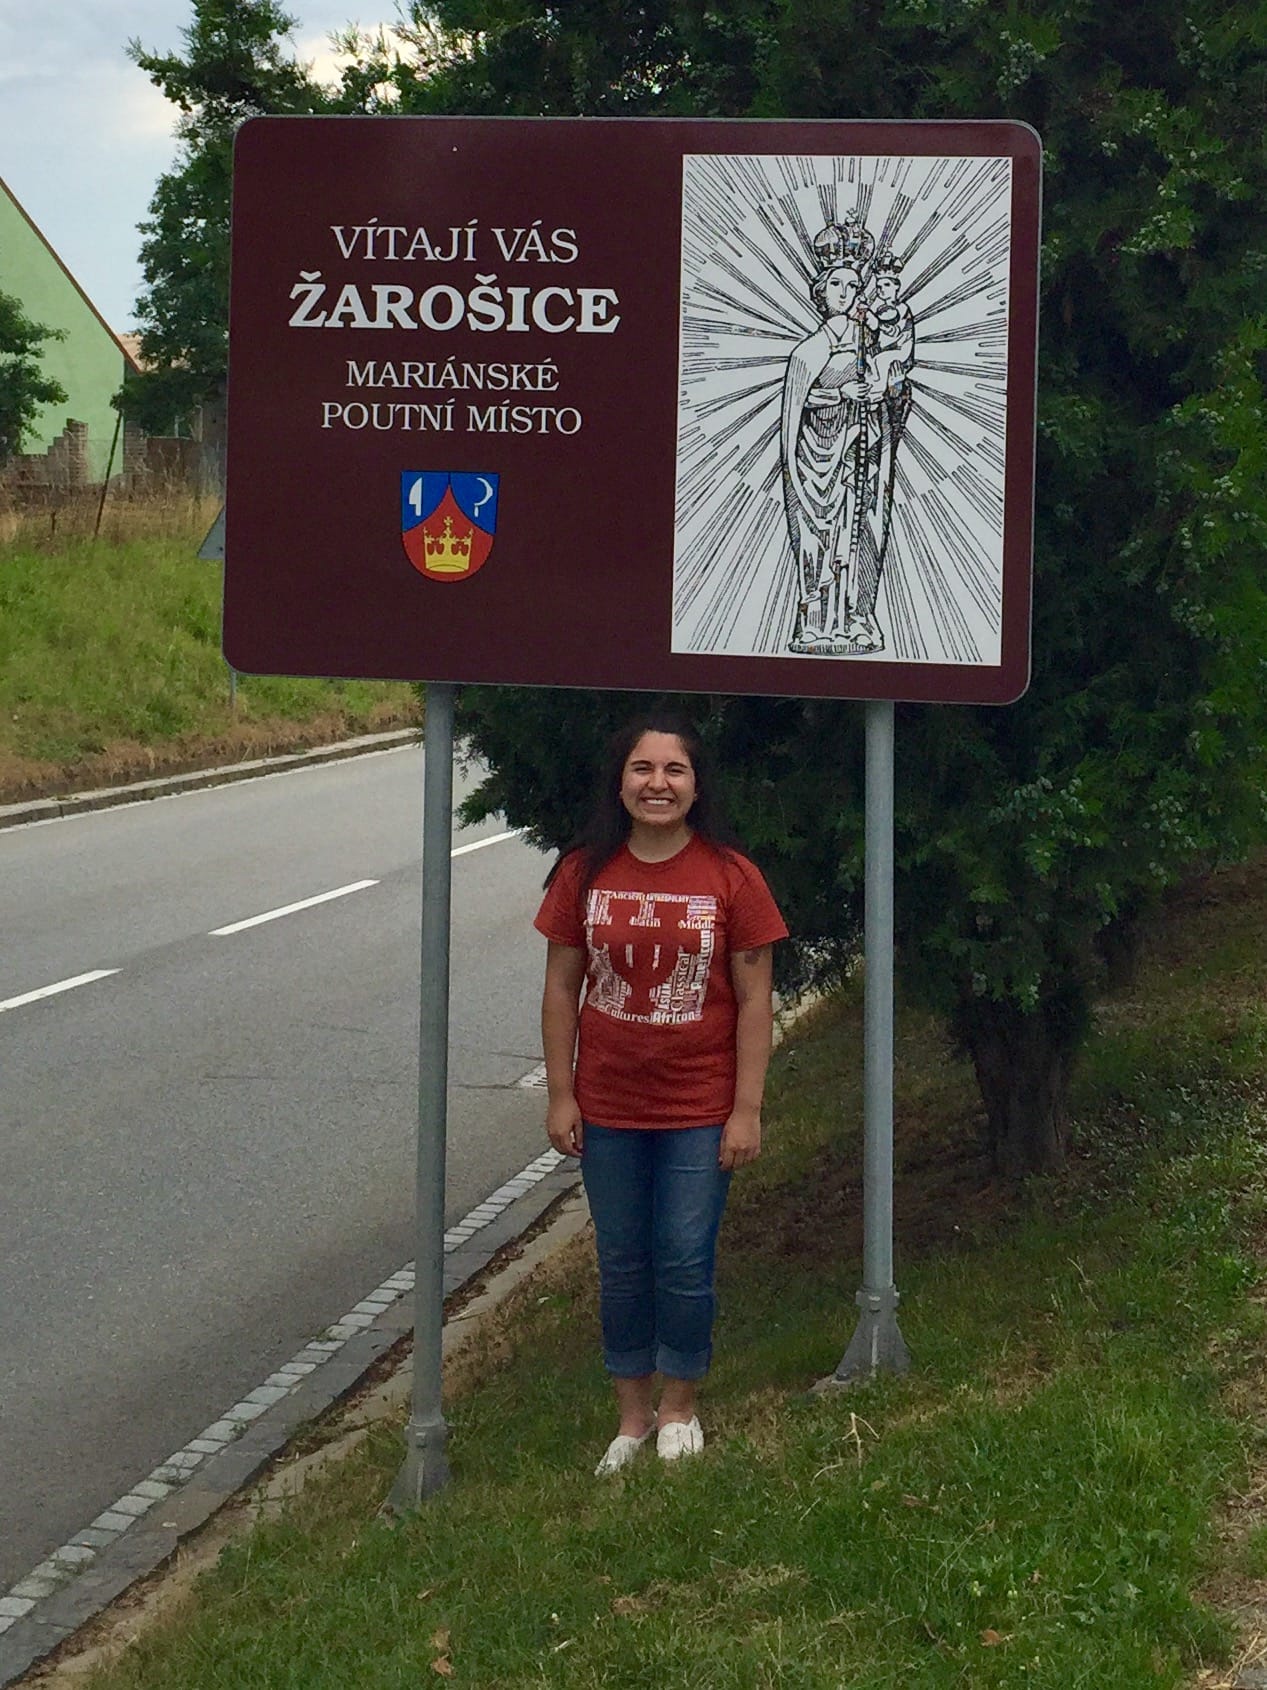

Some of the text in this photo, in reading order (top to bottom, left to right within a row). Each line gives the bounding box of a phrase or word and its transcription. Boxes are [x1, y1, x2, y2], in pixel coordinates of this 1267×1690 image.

[330, 217, 579, 264] VÍTAJÍ VÁS
[288, 270, 621, 333] ŽAROŠICE
[345, 355, 560, 391] MARIÁNSKÉ
[321, 397, 582, 435] POUTNÍ MÍSTO
[690, 930, 711, 990] American
[671, 952, 690, 1012] Classical
[604, 1004, 650, 1023] Cultures
[652, 1011, 695, 1023] African
